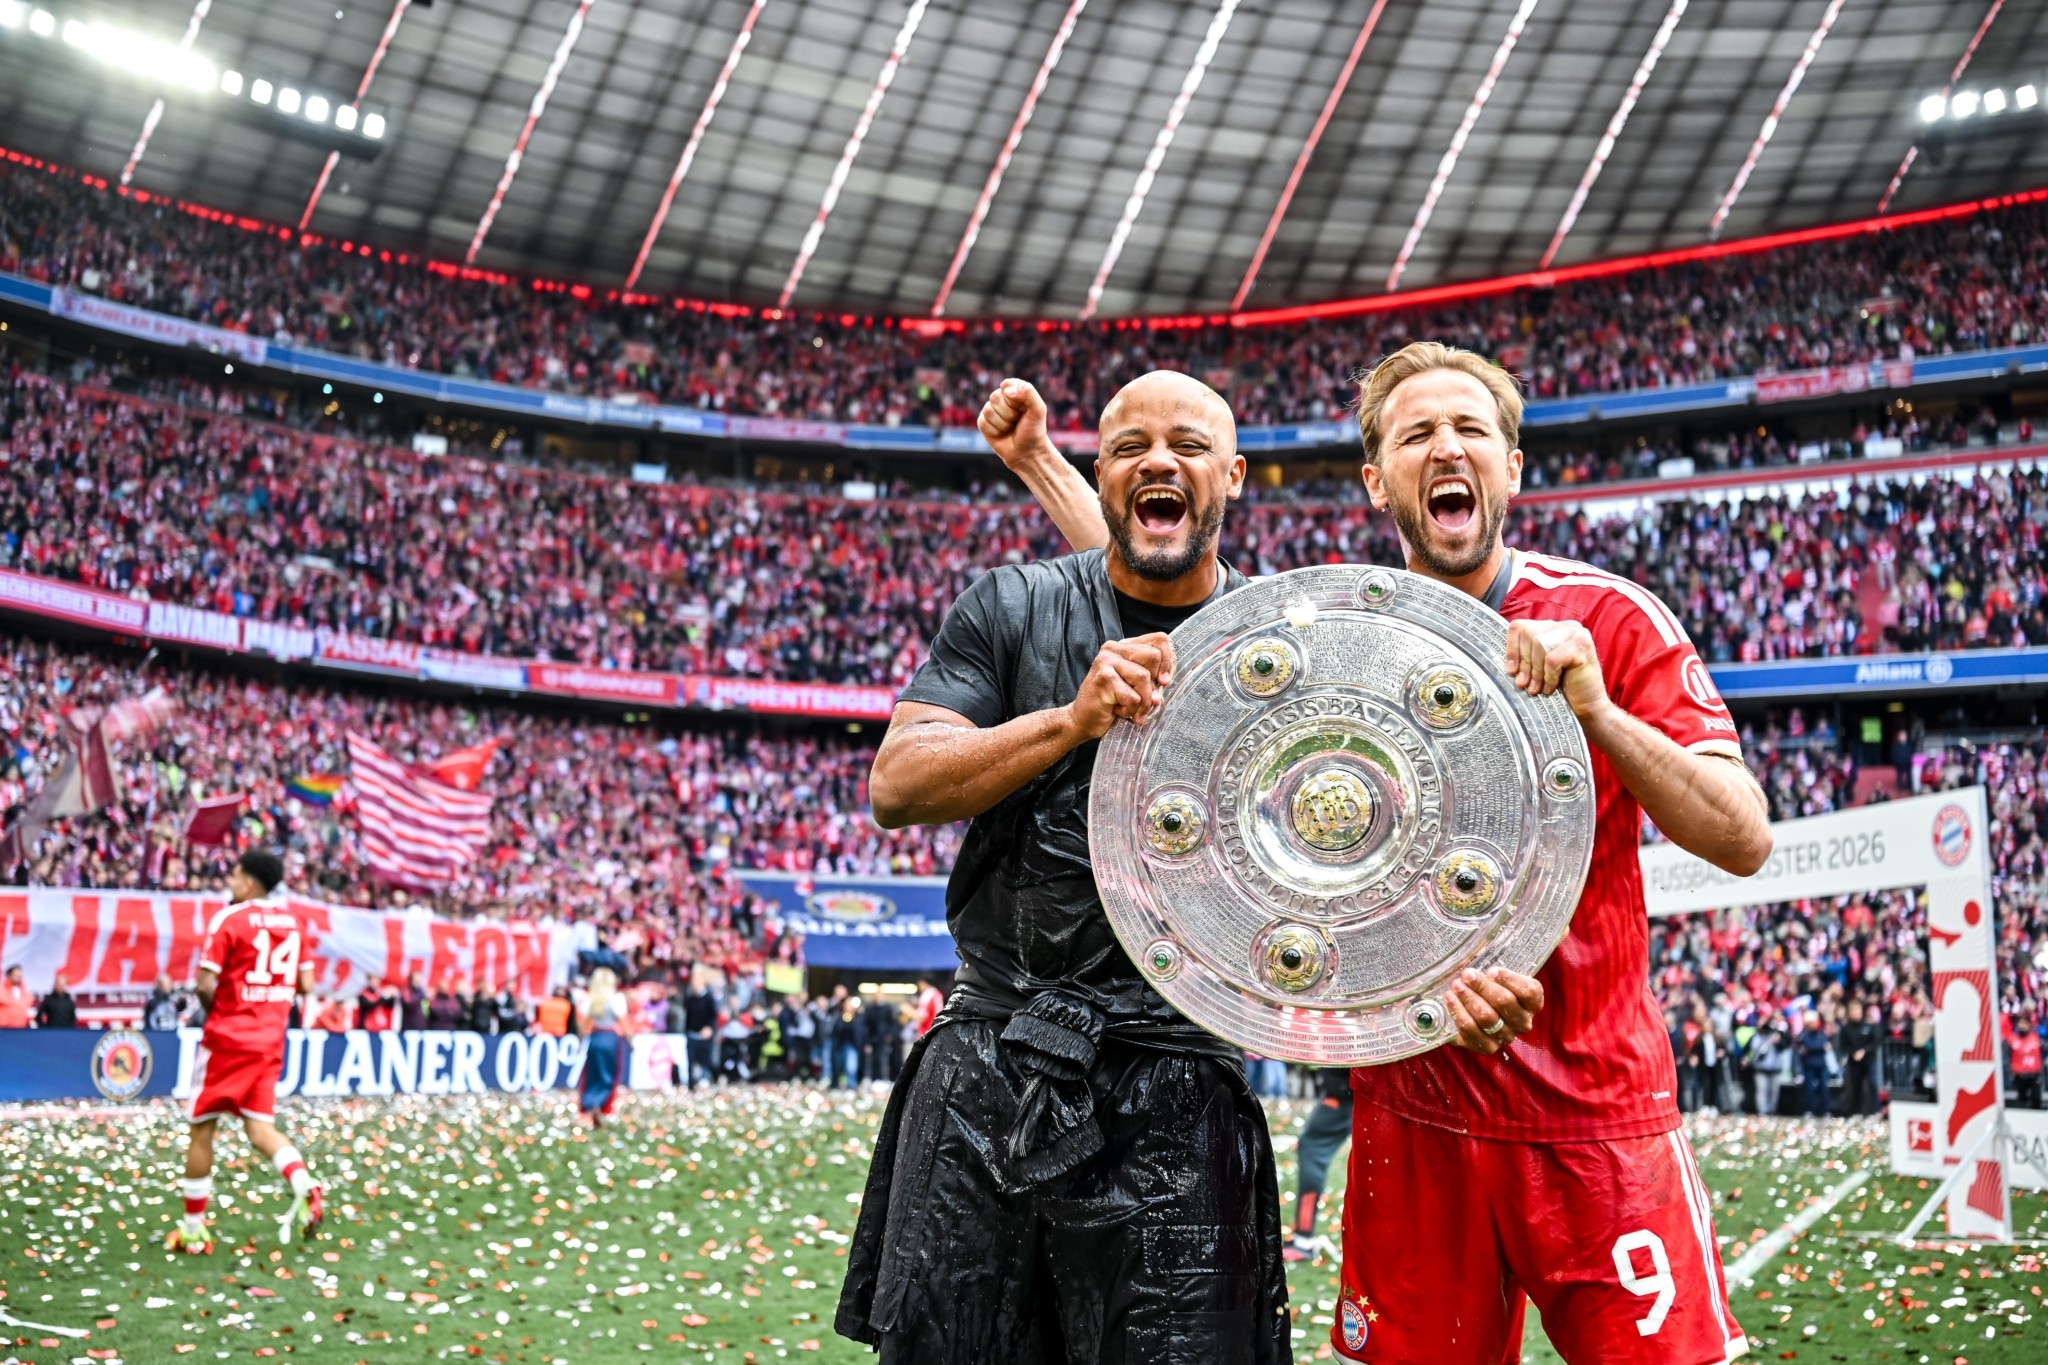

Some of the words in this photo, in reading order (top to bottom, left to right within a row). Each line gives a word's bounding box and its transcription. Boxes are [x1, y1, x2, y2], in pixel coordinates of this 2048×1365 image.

[149, 600, 240, 649] BAVARIA
[318, 627, 419, 669] PASSAU
[1855, 661, 1922, 684] Allianz
[1651, 844, 1822, 892] FUSSBAISTER
[1827, 830, 1887, 870] 2026
[245, 928, 300, 986] 14
[172, 1028, 488, 1098] ULANER
[2013, 1132, 2048, 1169] BA
[1611, 1228, 1676, 1337] 9
